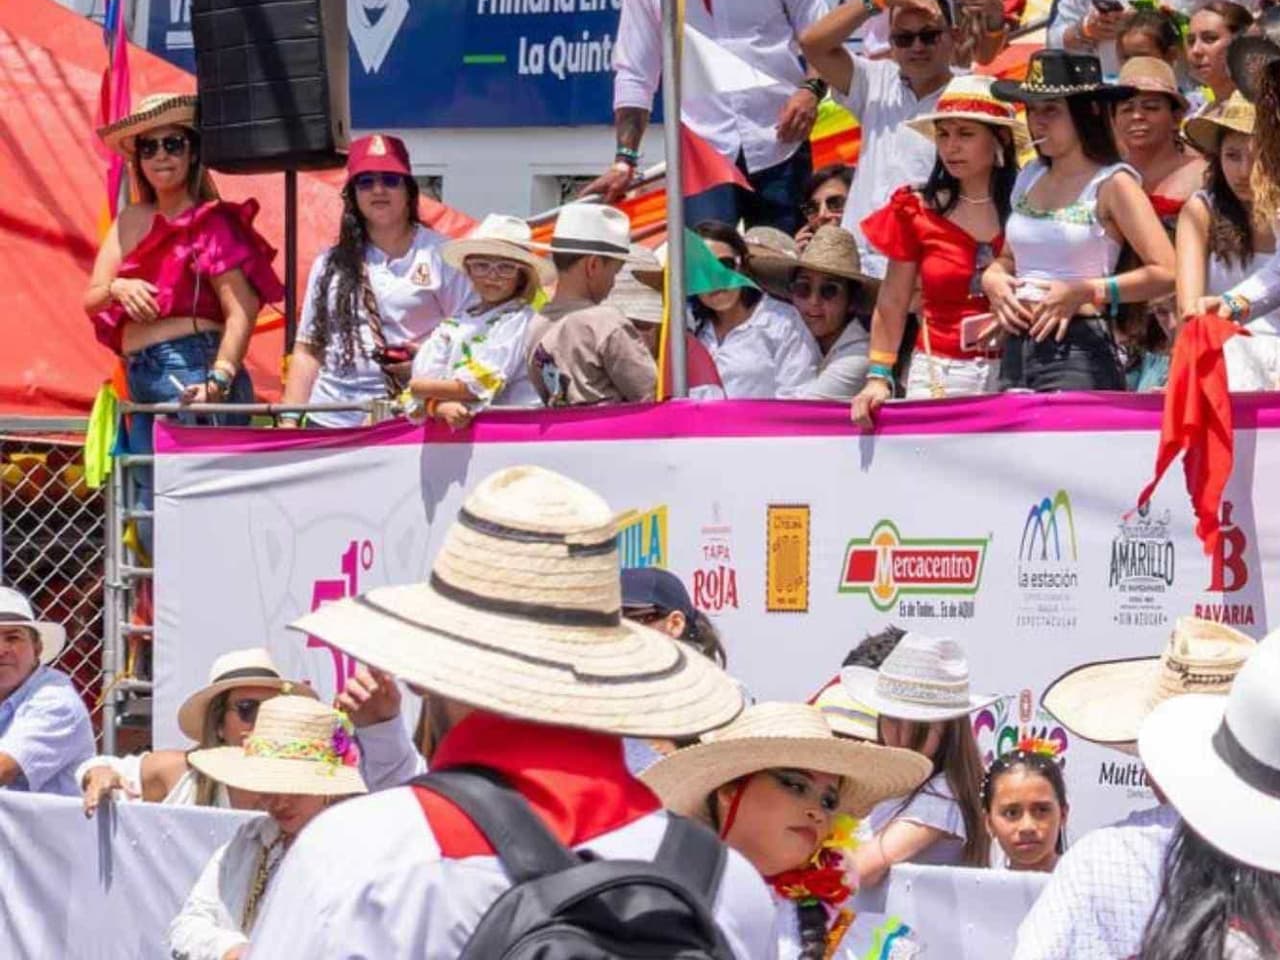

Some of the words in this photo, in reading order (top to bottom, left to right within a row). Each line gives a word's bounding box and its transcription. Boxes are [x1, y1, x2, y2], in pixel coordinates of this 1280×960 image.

[518, 37, 545, 74] La
[549, 29, 613, 80] Quint
[703, 545, 730, 560] TAPA
[877, 546, 974, 587] Mercacentro
[1109, 540, 1175, 588] AMARILLO
[694, 566, 738, 610] ROJA
[1018, 565, 1028, 588] la
[1031, 567, 1078, 588] estación
[1195, 604, 1255, 625] BAVARIA
